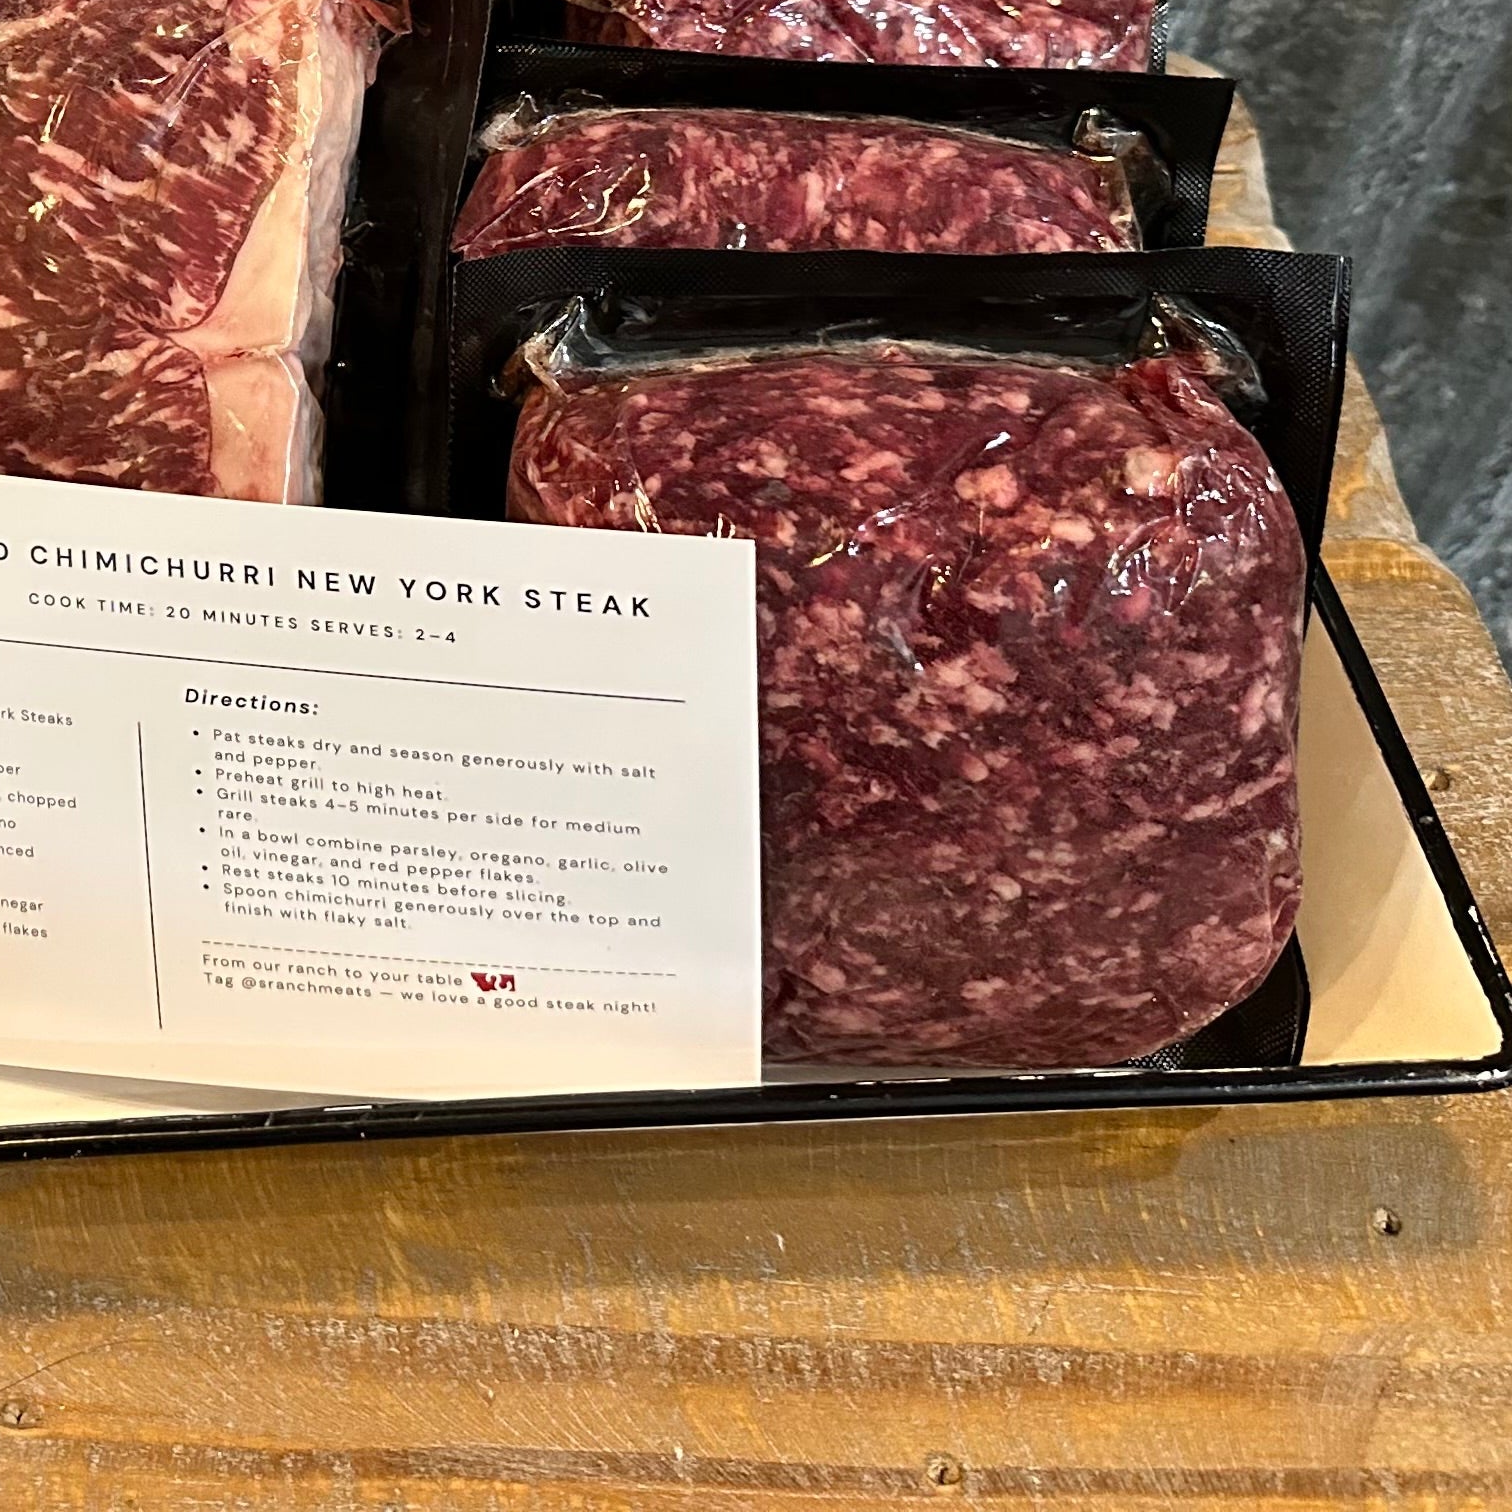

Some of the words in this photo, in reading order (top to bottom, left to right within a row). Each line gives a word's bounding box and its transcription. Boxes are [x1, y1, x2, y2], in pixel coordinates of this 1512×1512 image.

[30, 545, 274, 586] CHIMICHURRI
[298, 570, 376, 595] NEW
[398, 578, 500, 606] YORK
[524, 589, 650, 618] STEAK
[29, 593, 86, 609] COOK
[97, 600, 154, 616] TIME:
[166, 606, 190, 619] 20
[203, 610, 297, 630] MINUTES
[311, 619, 402, 639] SERVES:
[21, 709, 72, 726] Steaks
[185, 688, 318, 716] Directions:
[214, 729, 240, 743] Pat
[248, 734, 305, 749] steaks
[313, 739, 342, 755] dry
[350, 744, 382, 756] and
[390, 748, 454, 762] season
[462, 755, 564, 774] generously
[572, 762, 613, 776] with
[621, 766, 655, 779] salt
[214, 751, 245, 762] and
[253, 756, 320, 770] pepper.
[8, 791, 76, 808] chopped
[216, 768, 283, 787] Preheat
[291, 777, 324, 791] grill
[332, 781, 350, 792] to
[357, 782, 395, 798] high
[403, 786, 449, 801] heat.
[217, 788, 252, 803] Grill
[260, 794, 317, 808] steaks
[366, 803, 439, 820] minutes
[448, 812, 477, 823] per
[486, 813, 523, 826] side
[532, 816, 557, 829] for
[566, 821, 640, 835] medium
[218, 810, 258, 822] rare.
[220, 826, 234, 838] In
[242, 831, 250, 840] a
[258, 829, 298, 845] bowl
[306, 837, 382, 852] combine
[390, 845, 462, 862] parsley,
[470, 852, 550, 867] oregano,
[558, 858, 615, 872] garlic,
[624, 860, 668, 874] olive
[221, 846, 245, 860] oil,
[253, 848, 322, 868] vinegar,
[330, 858, 362, 869] and
[370, 861, 398, 872] red
[407, 865, 472, 880] pepper
[480, 868, 538, 884] flakes.
[222, 864, 260, 879] Rest
[268, 870, 324, 884] steaks
[332, 874, 350, 887] 10
[358, 878, 429, 894] minutes
[438, 883, 497, 899] before
[506, 889, 571, 907] slicing.
[224, 882, 277, 899] Spoon
[285, 889, 386, 909] chimichurri
[394, 901, 494, 920] generously
[502, 910, 542, 920] over
[551, 910, 580, 923] the
[588, 914, 619, 927] top
[628, 916, 660, 927] and
[225, 901, 272, 917] finish
[280, 908, 316, 920] with
[324, 910, 366, 927] flaky
[374, 916, 412, 929] salt.
[3, 922, 47, 938] flakes
[203, 954, 245, 968] From
[253, 962, 280, 972] our
[288, 964, 337, 976] ranch
[345, 968, 362, 979] to
[370, 971, 409, 983] your
[418, 974, 463, 985] table
[204, 972, 233, 988] Tag
[242, 977, 371, 997] @sranchmeats
[400, 992, 424, 1001] we
[432, 991, 468, 1004] love
[494, 997, 538, 1008] good
[546, 1000, 594, 1010] steak
[604, 1001, 656, 1014] night!
